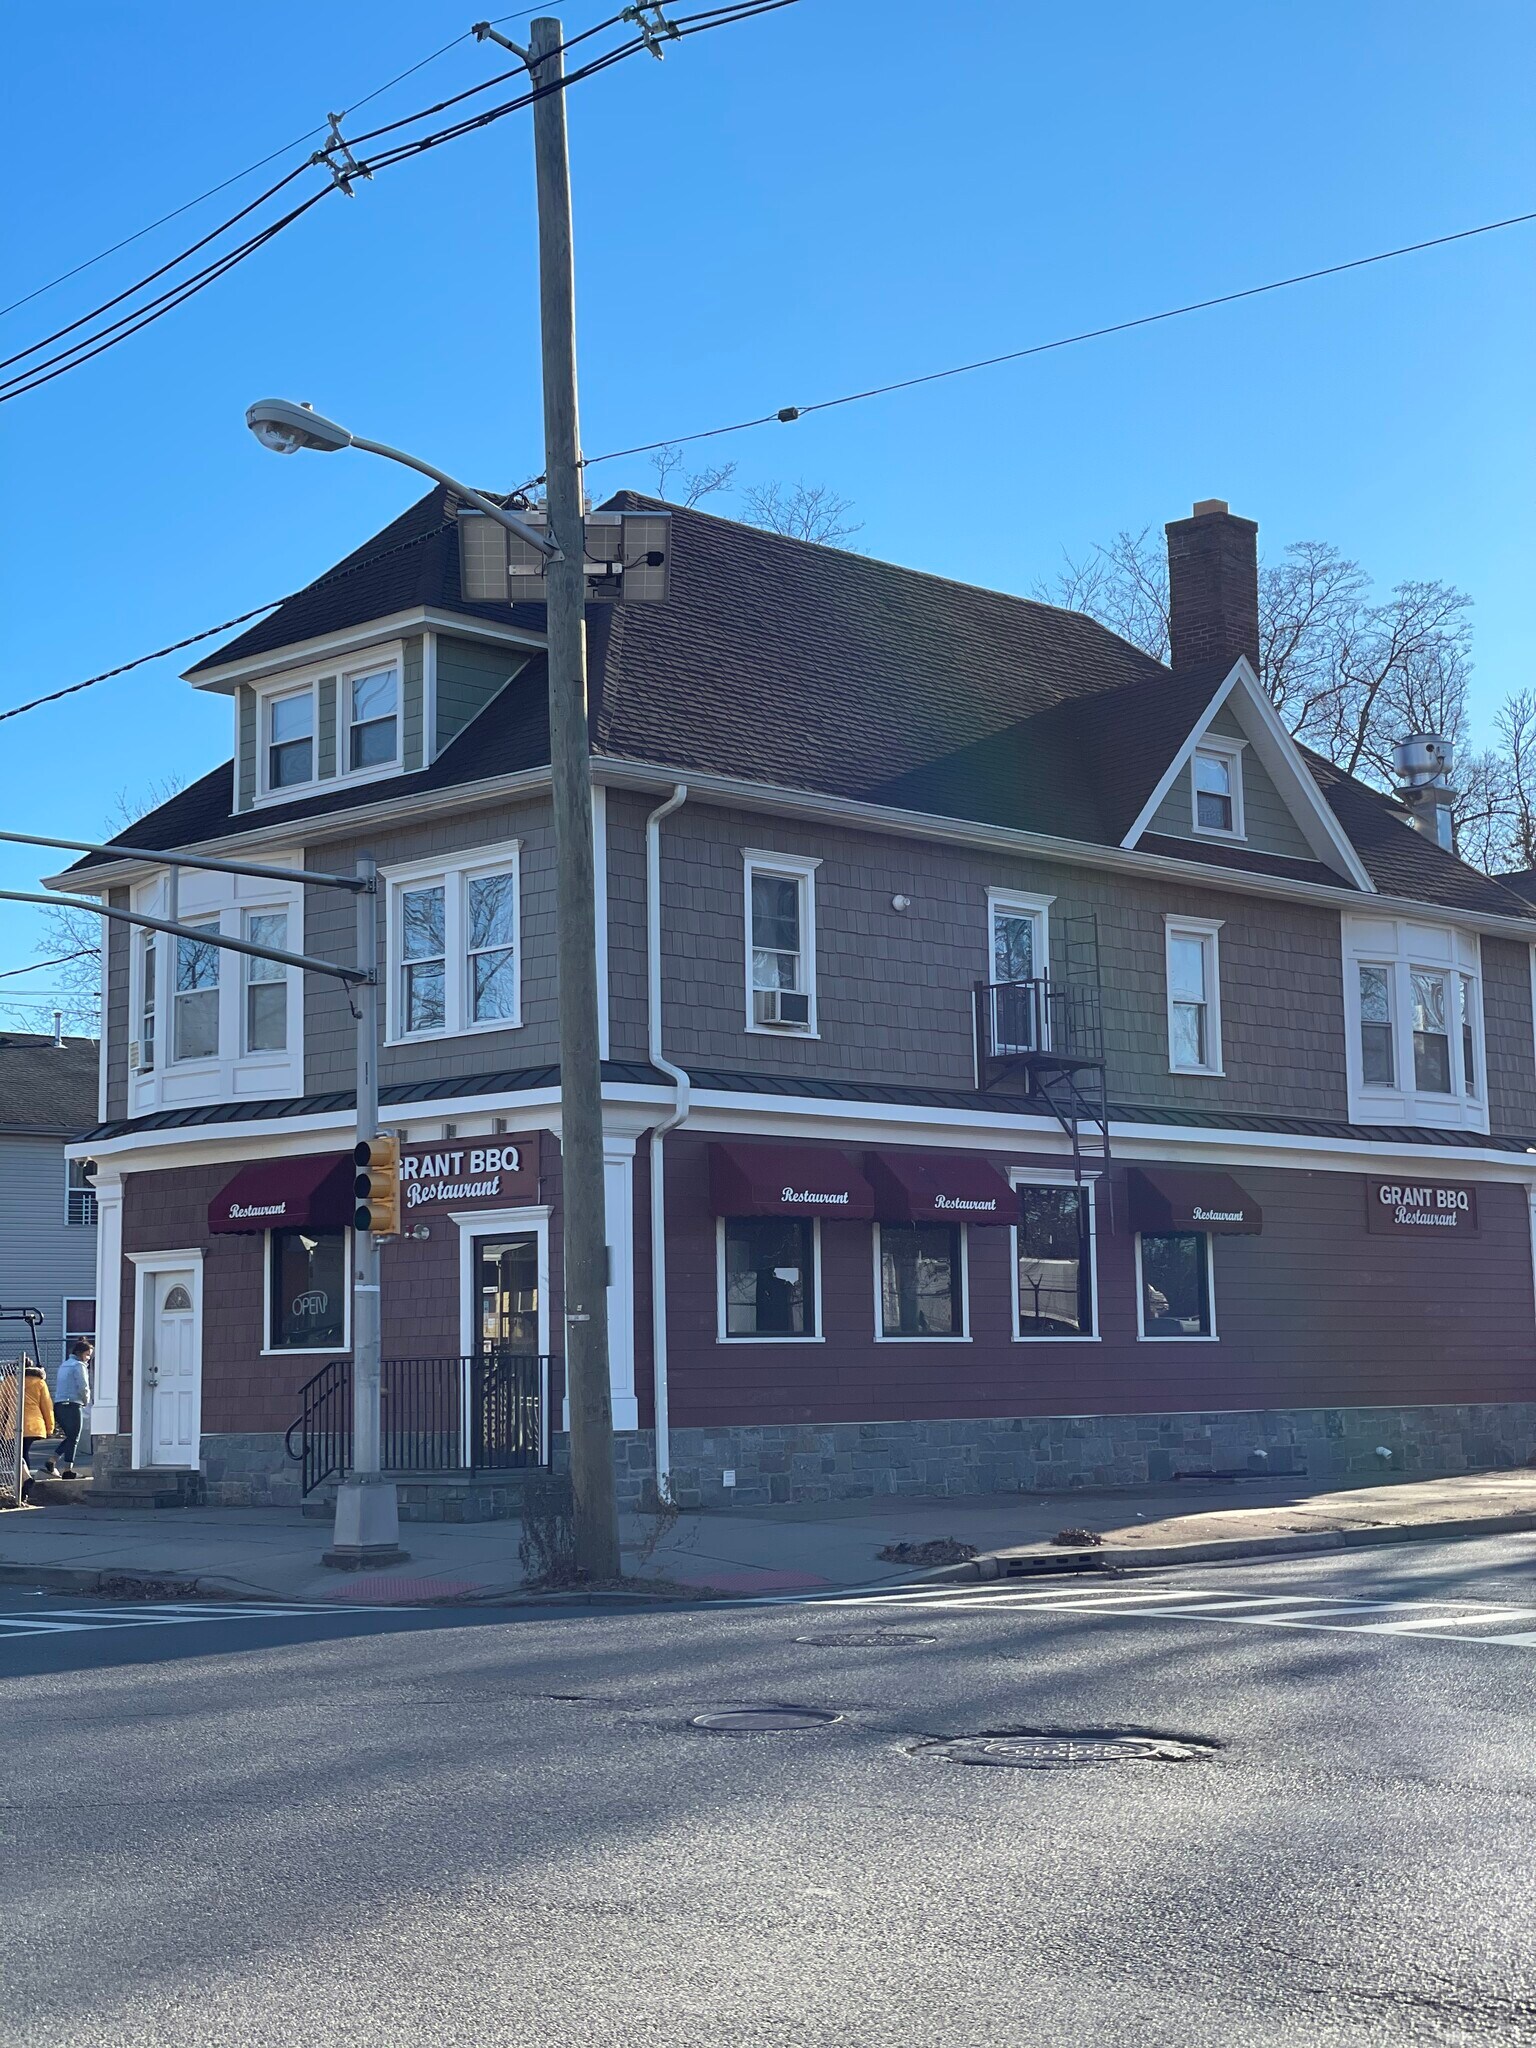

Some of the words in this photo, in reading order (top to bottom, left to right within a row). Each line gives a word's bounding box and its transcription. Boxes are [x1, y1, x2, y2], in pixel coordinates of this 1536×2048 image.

[470, 1146, 520, 1174] BBQ
[407, 1175, 500, 1208] Restaurant
[781, 1186, 849, 1204] Restaurant
[1379, 1185, 1432, 1207] GRANT
[1437, 1189, 1469, 1211] BBQ
[229, 1202, 286, 1219] Restaurant
[934, 1194, 997, 1211] Restaurant
[1192, 1206, 1244, 1221] Restaurant
[1394, 1205, 1457, 1226] Restaurant
[292, 1296, 327, 1316] OPEN
